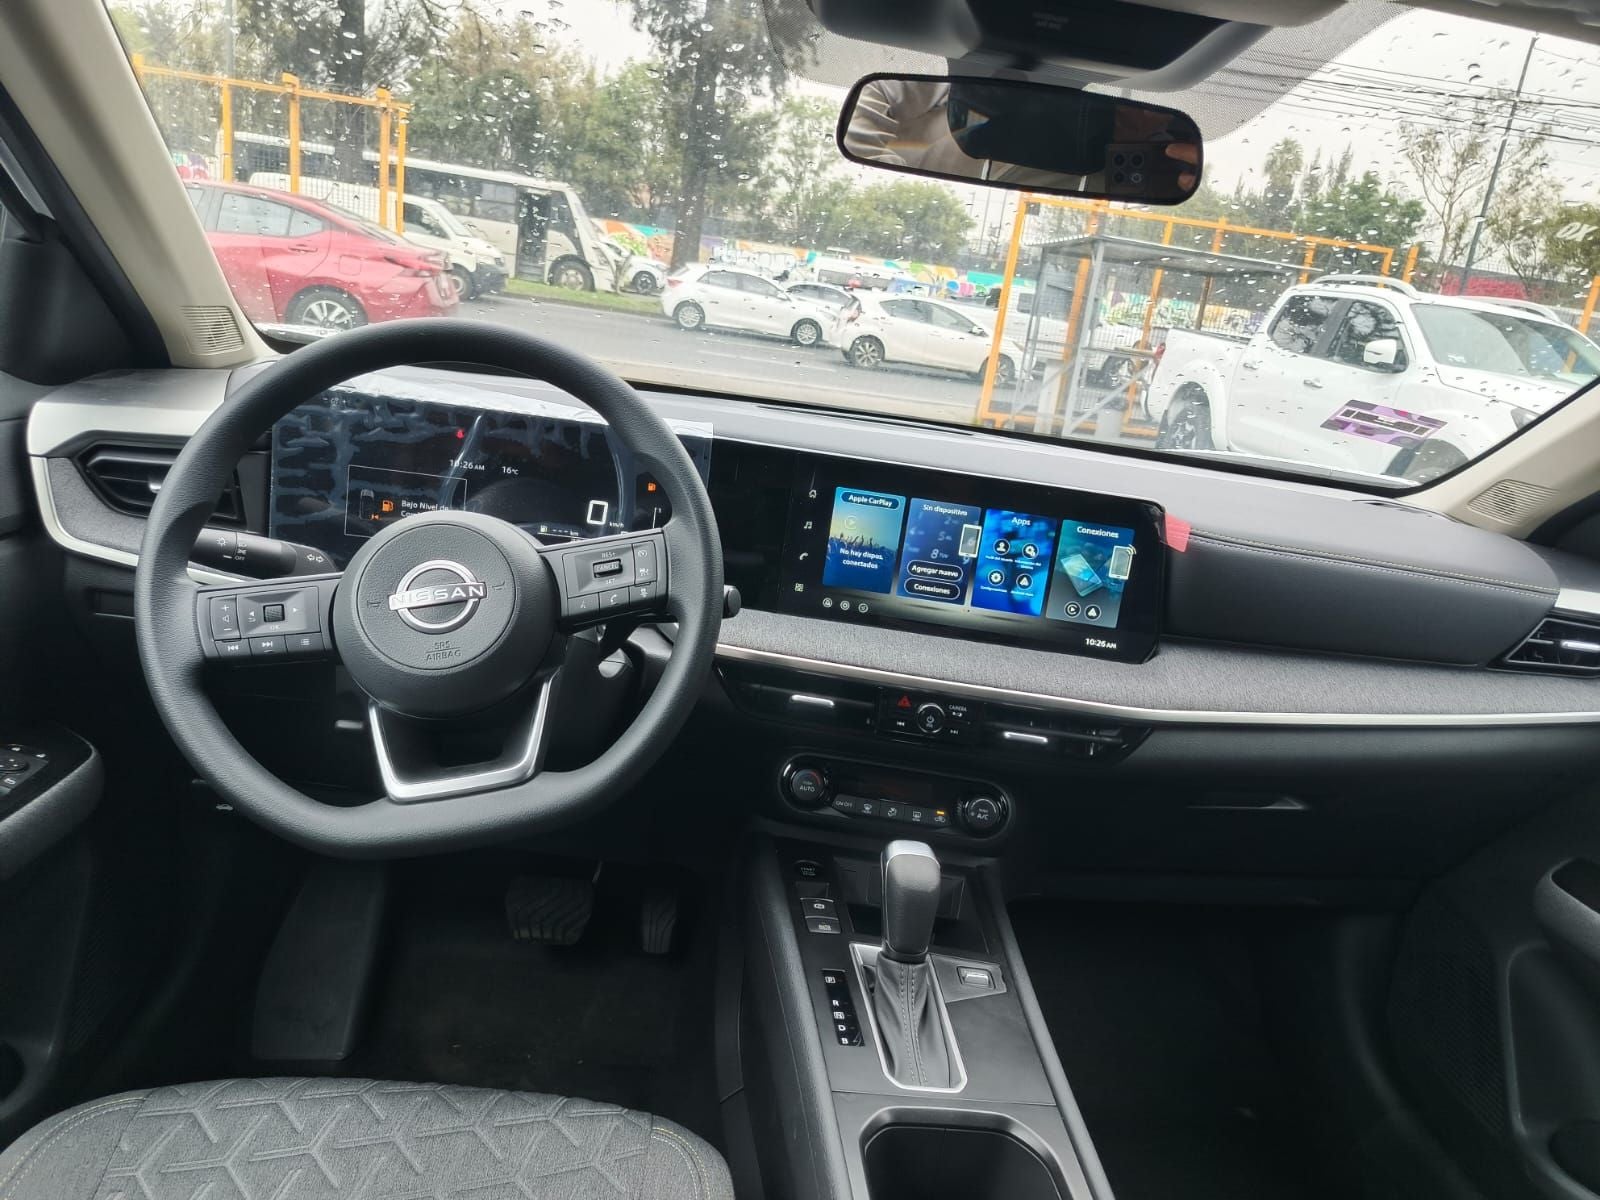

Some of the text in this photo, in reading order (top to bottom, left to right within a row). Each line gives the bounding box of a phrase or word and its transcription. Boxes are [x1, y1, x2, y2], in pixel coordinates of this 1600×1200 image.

[401, 499, 418, 509] Bajo
[419, 501, 438, 511] Nivel
[848, 494, 893, 508] Apple CarPlay
[587, 499, 608, 525] 0
[923, 503, 934, 511] Sin
[1011, 516, 1031, 527] Apps
[1076, 525, 1120, 539] Conexiones
[850, 549, 862, 558] hay
[842, 559, 878, 569] conectados
[911, 564, 959, 578] Agregar nuevo
[914, 583, 951, 595] Conexiones
[390, 585, 485, 609] NISSAN
[434, 640, 450, 650] SRS
[427, 649, 461, 661] AIRBAG
[949, 704, 967, 712] CAMERA
[799, 784, 815, 792] AUTO
[832, 999, 840, 1007] R
